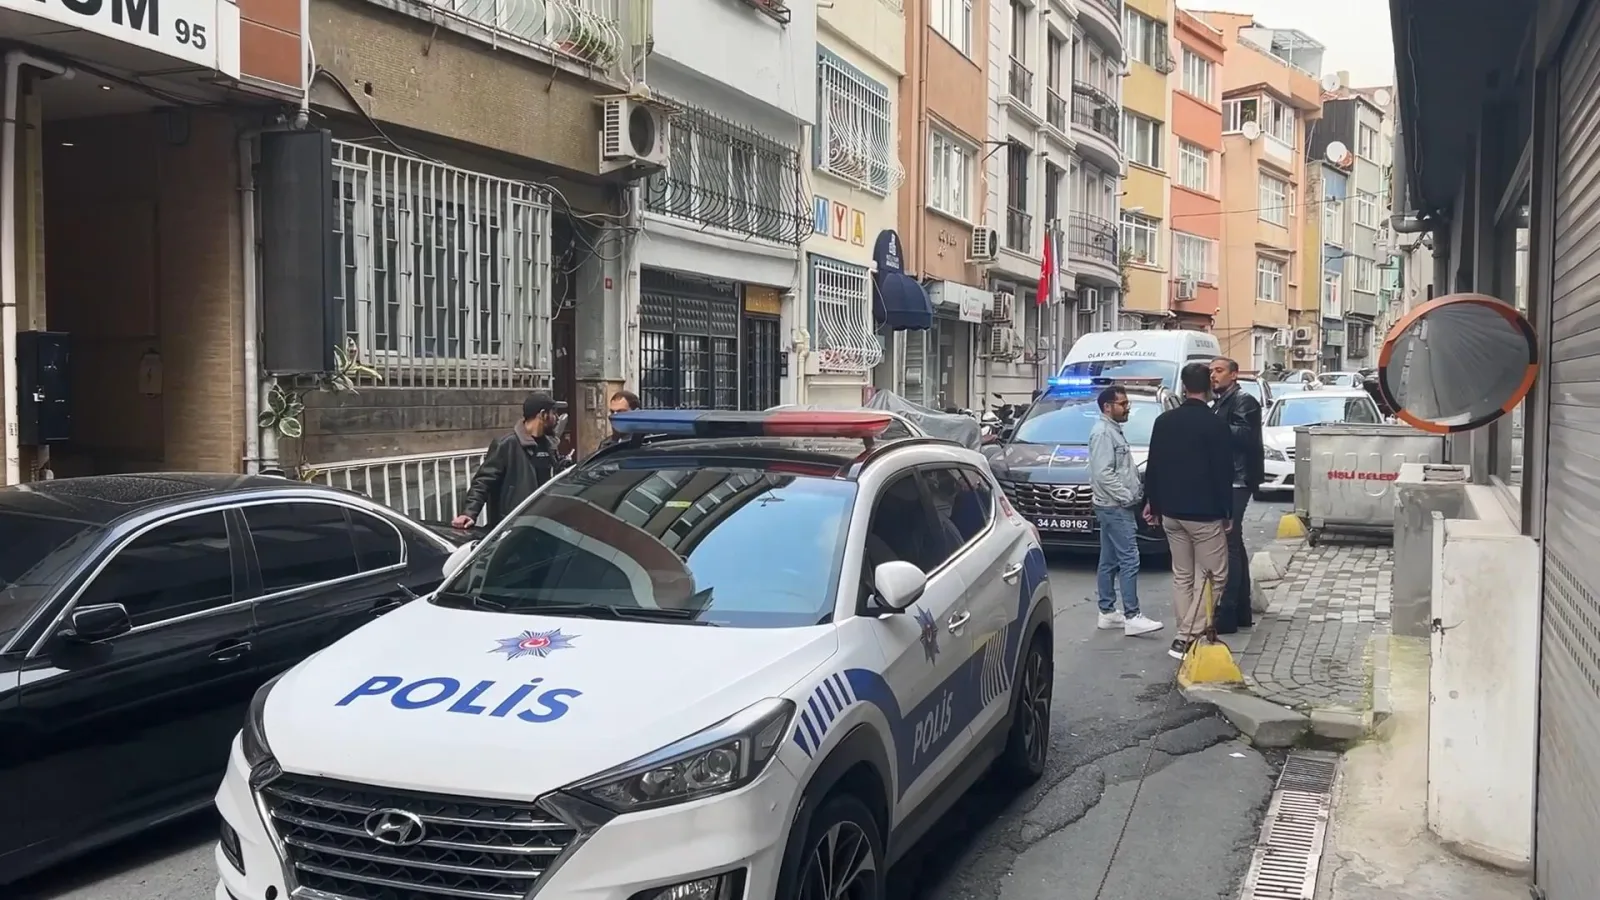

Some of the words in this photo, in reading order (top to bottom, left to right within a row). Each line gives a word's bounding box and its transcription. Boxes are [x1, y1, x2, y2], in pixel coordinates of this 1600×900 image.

[175, 18, 207, 50] 95
[1087, 351, 1105, 359] OLAY
[1037, 518, 1049, 528] 34
[1050, 519, 1058, 528] A
[1060, 519, 1088, 529] 89162
[334, 676, 583, 723] POLİS
[912, 689, 953, 765] POLİS
